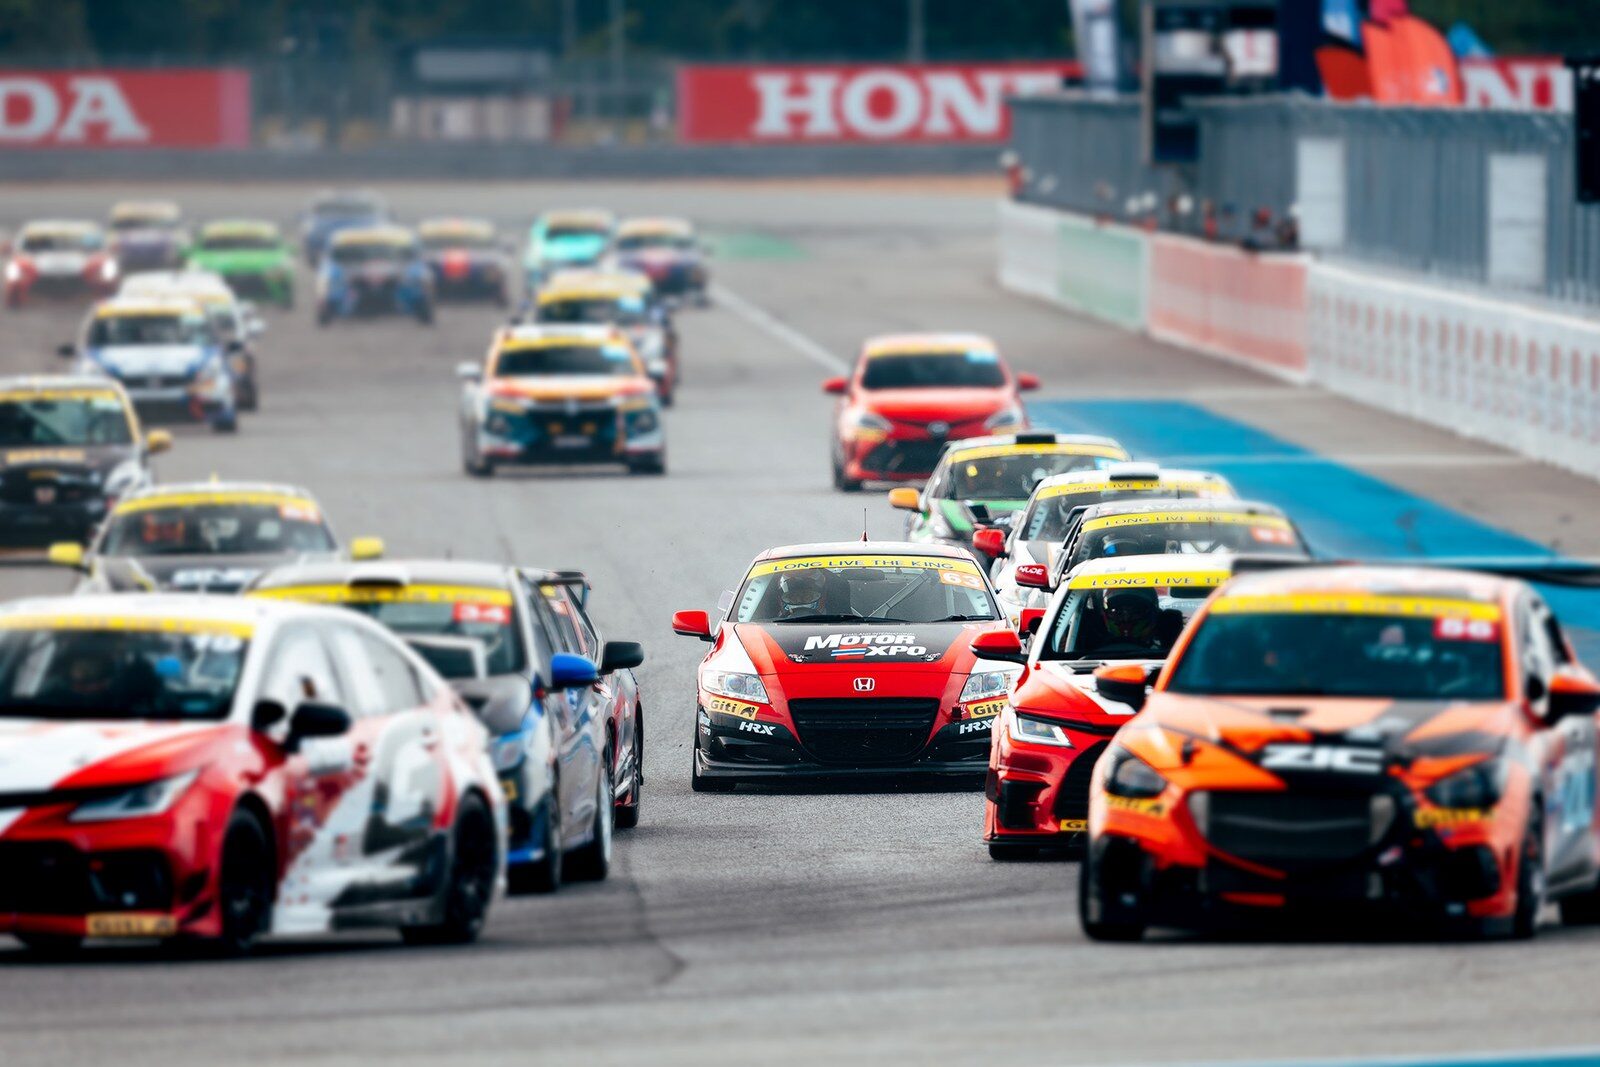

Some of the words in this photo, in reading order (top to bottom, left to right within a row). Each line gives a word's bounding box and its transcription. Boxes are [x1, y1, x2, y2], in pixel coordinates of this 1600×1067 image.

[772, 561, 823, 572] LONG
[828, 559, 865, 567] LIVE
[872, 559, 902, 567] THE
[911, 560, 954, 570] KING
[943, 572, 981, 588] 63
[1092, 577, 1147, 586] LONG
[1154, 576, 1194, 585] LIVE
[803, 633, 916, 651] MOTOR
[711, 699, 738, 714] Giti
[739, 721, 777, 736] HRX
